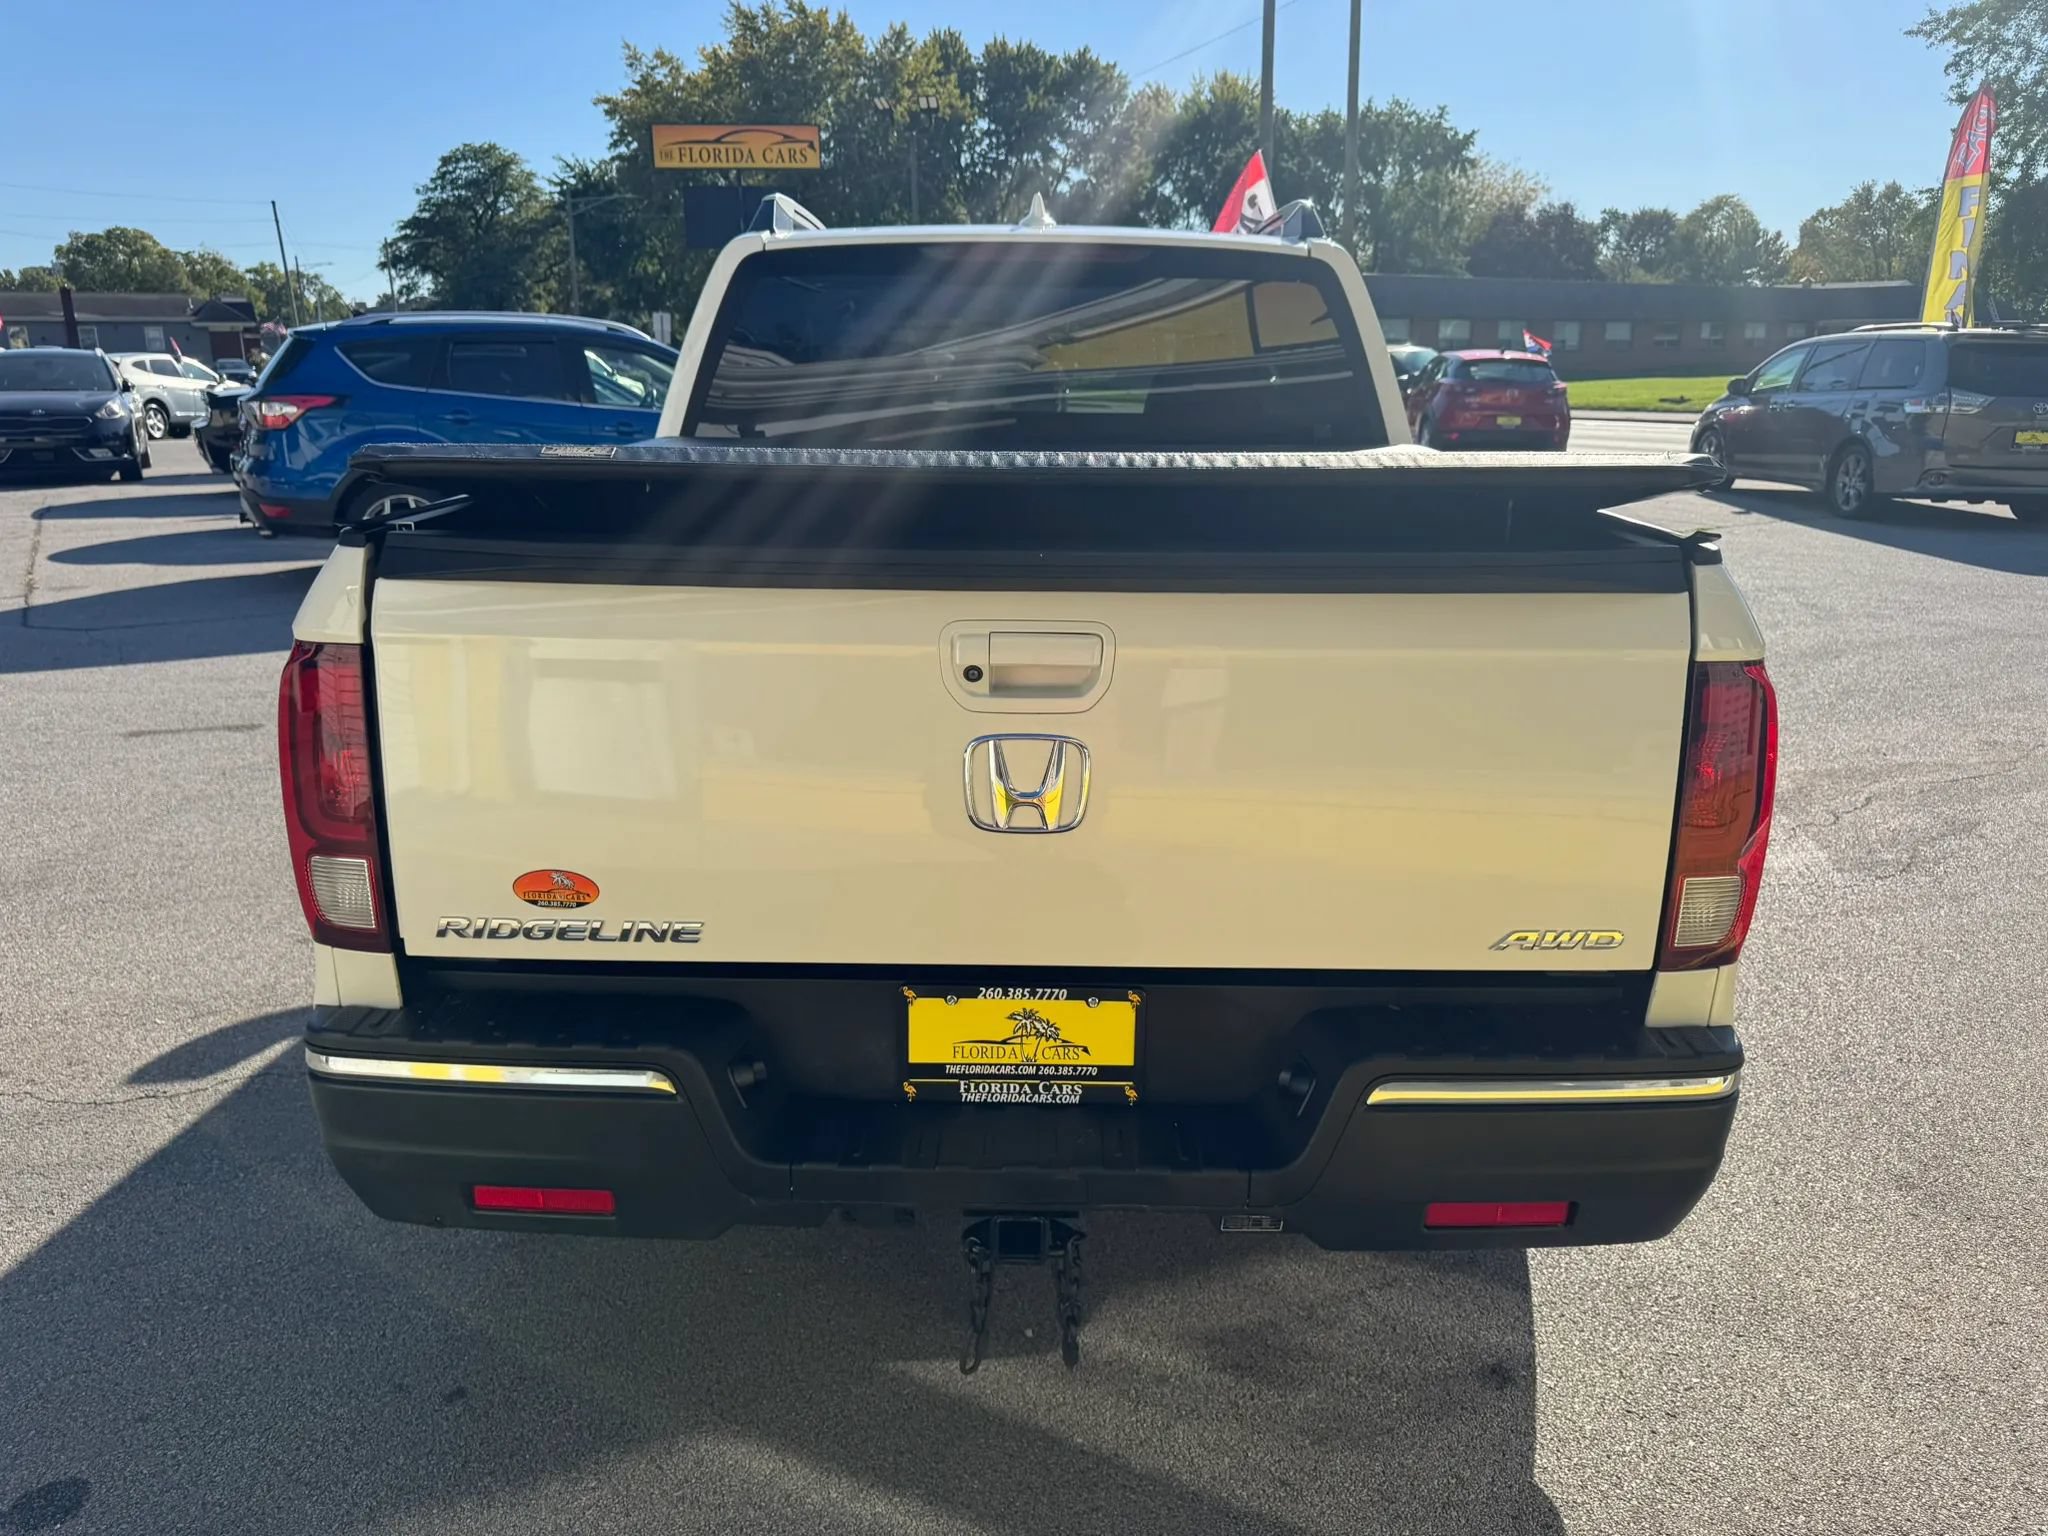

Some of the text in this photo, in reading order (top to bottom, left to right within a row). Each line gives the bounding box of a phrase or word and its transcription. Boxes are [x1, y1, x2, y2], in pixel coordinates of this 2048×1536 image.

[678, 146, 756, 164] FLORIDA
[762, 147, 808, 164] CARS
[523, 891, 586, 901] FLORIDA CARS
[537, 900, 577, 908] 260.385.7770
[435, 916, 705, 944] RIDGELINE
[1488, 929, 1625, 951] AWD
[977, 987, 1067, 1000] 260.385.7770
[953, 1045, 1080, 1060] FLORIDA CARS
[945, 1064, 1098, 1076] THEFLORIDACARS.COM 260.385.7770
[960, 1080, 1083, 1095] FLORIDA CARS
[961, 1093, 1080, 1104] THEFLORIDACARS.COM
